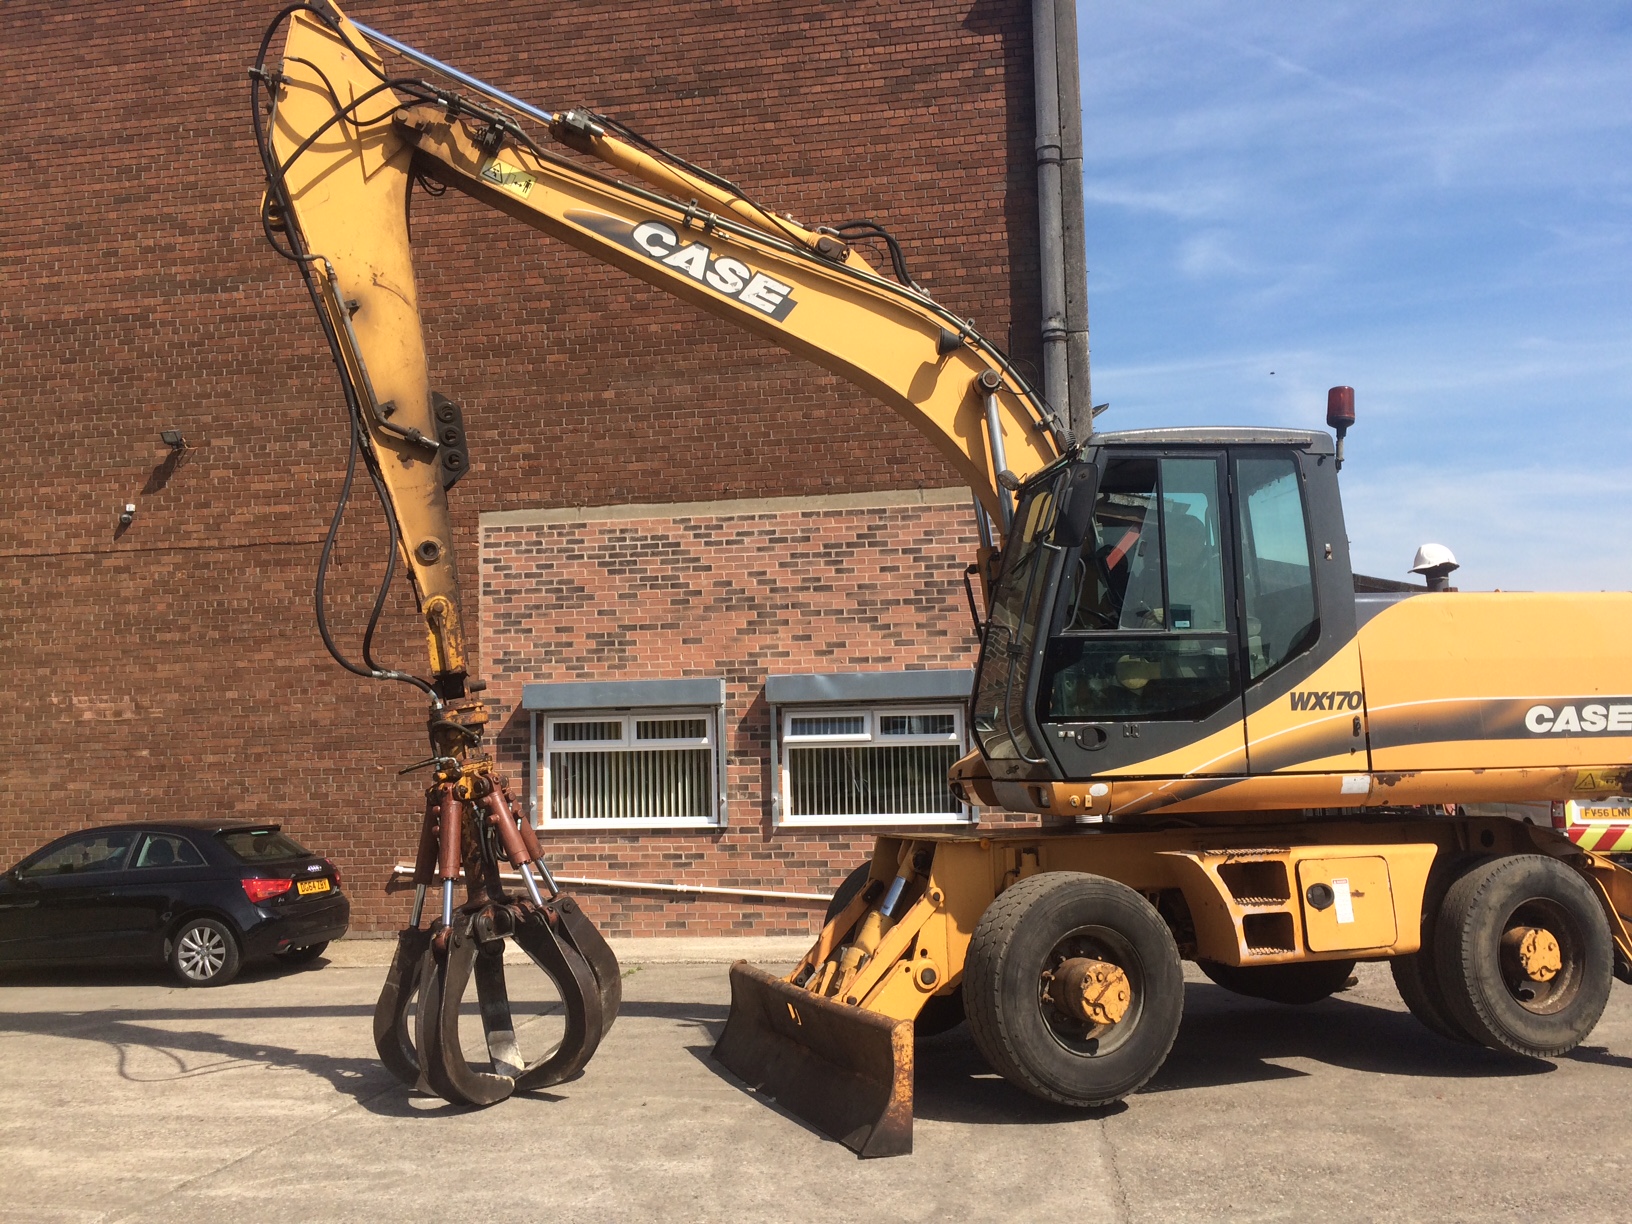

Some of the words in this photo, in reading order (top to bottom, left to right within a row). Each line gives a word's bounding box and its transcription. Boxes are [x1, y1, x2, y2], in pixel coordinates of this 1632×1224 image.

[632, 222, 793, 314] CASE
[1290, 691, 1363, 711] WX170
[1525, 704, 1632, 733] CASE
[1611, 807, 1631, 817] LNN
